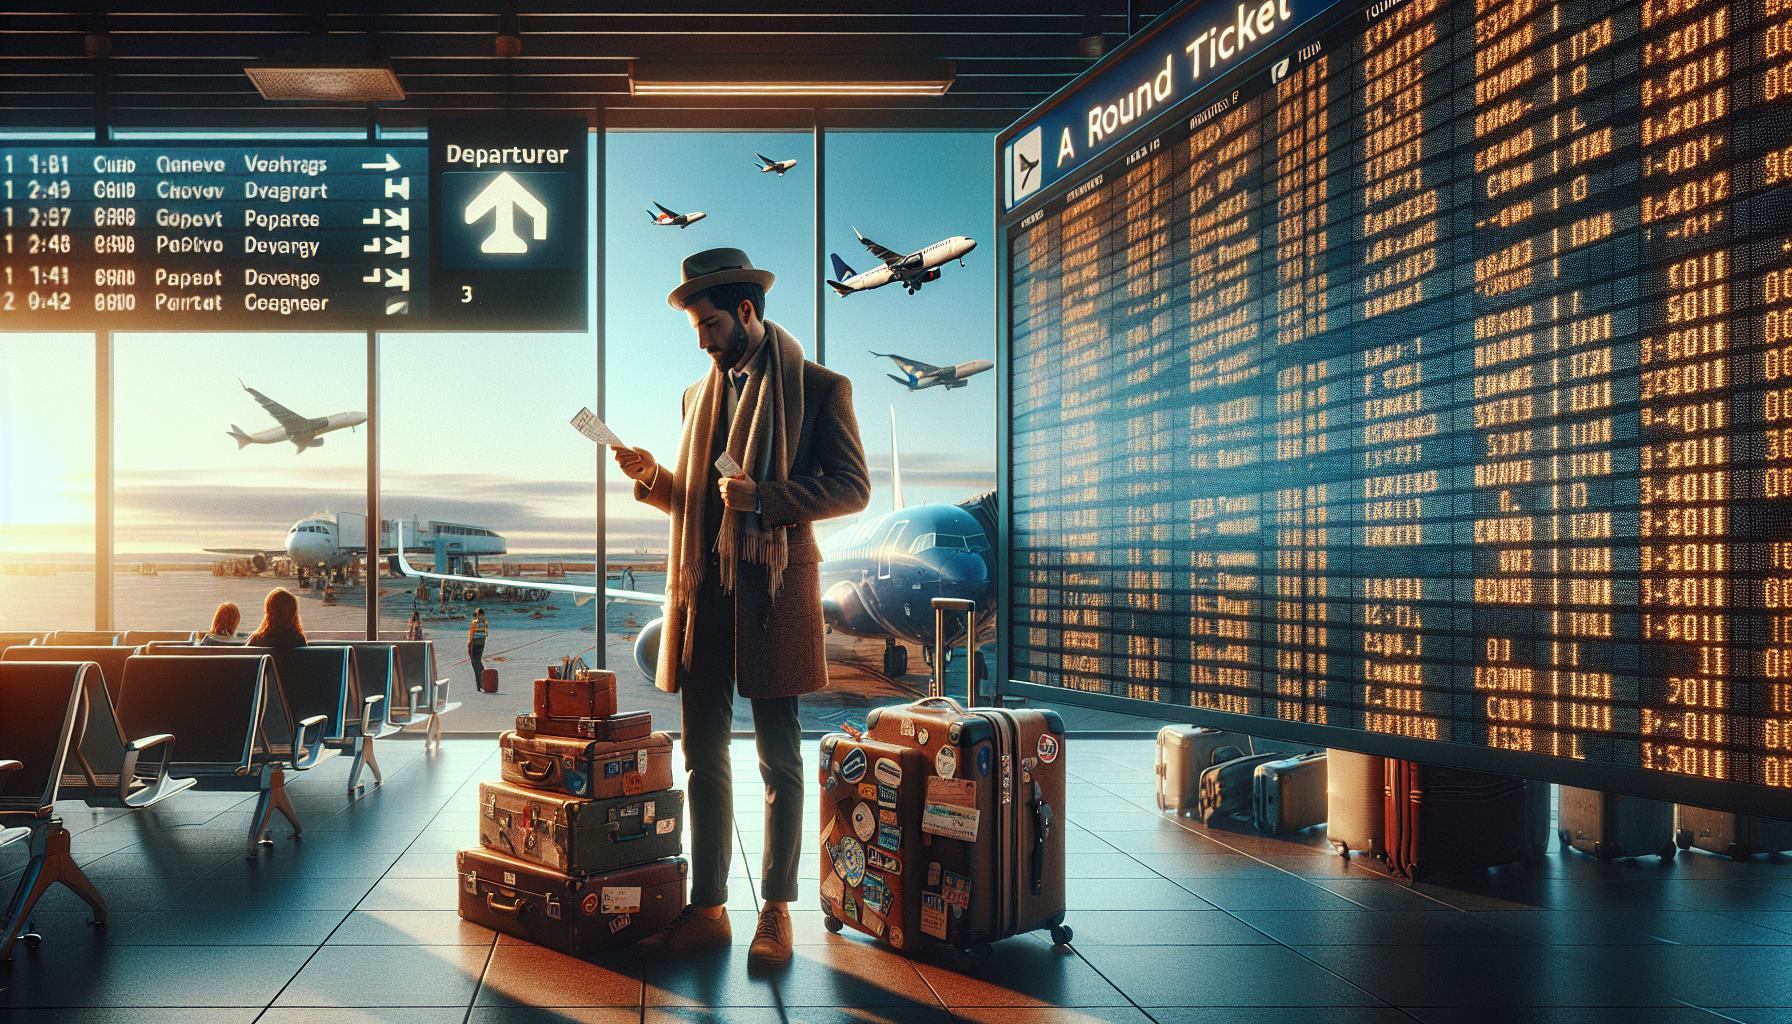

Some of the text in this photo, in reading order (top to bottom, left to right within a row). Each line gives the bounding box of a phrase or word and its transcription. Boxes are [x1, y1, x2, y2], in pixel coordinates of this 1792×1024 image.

[1057, 127, 1075, 168] A
[1088, 54, 1172, 148] Round
[446, 144, 569, 168] Departurer
[461, 285, 473, 304] 3
